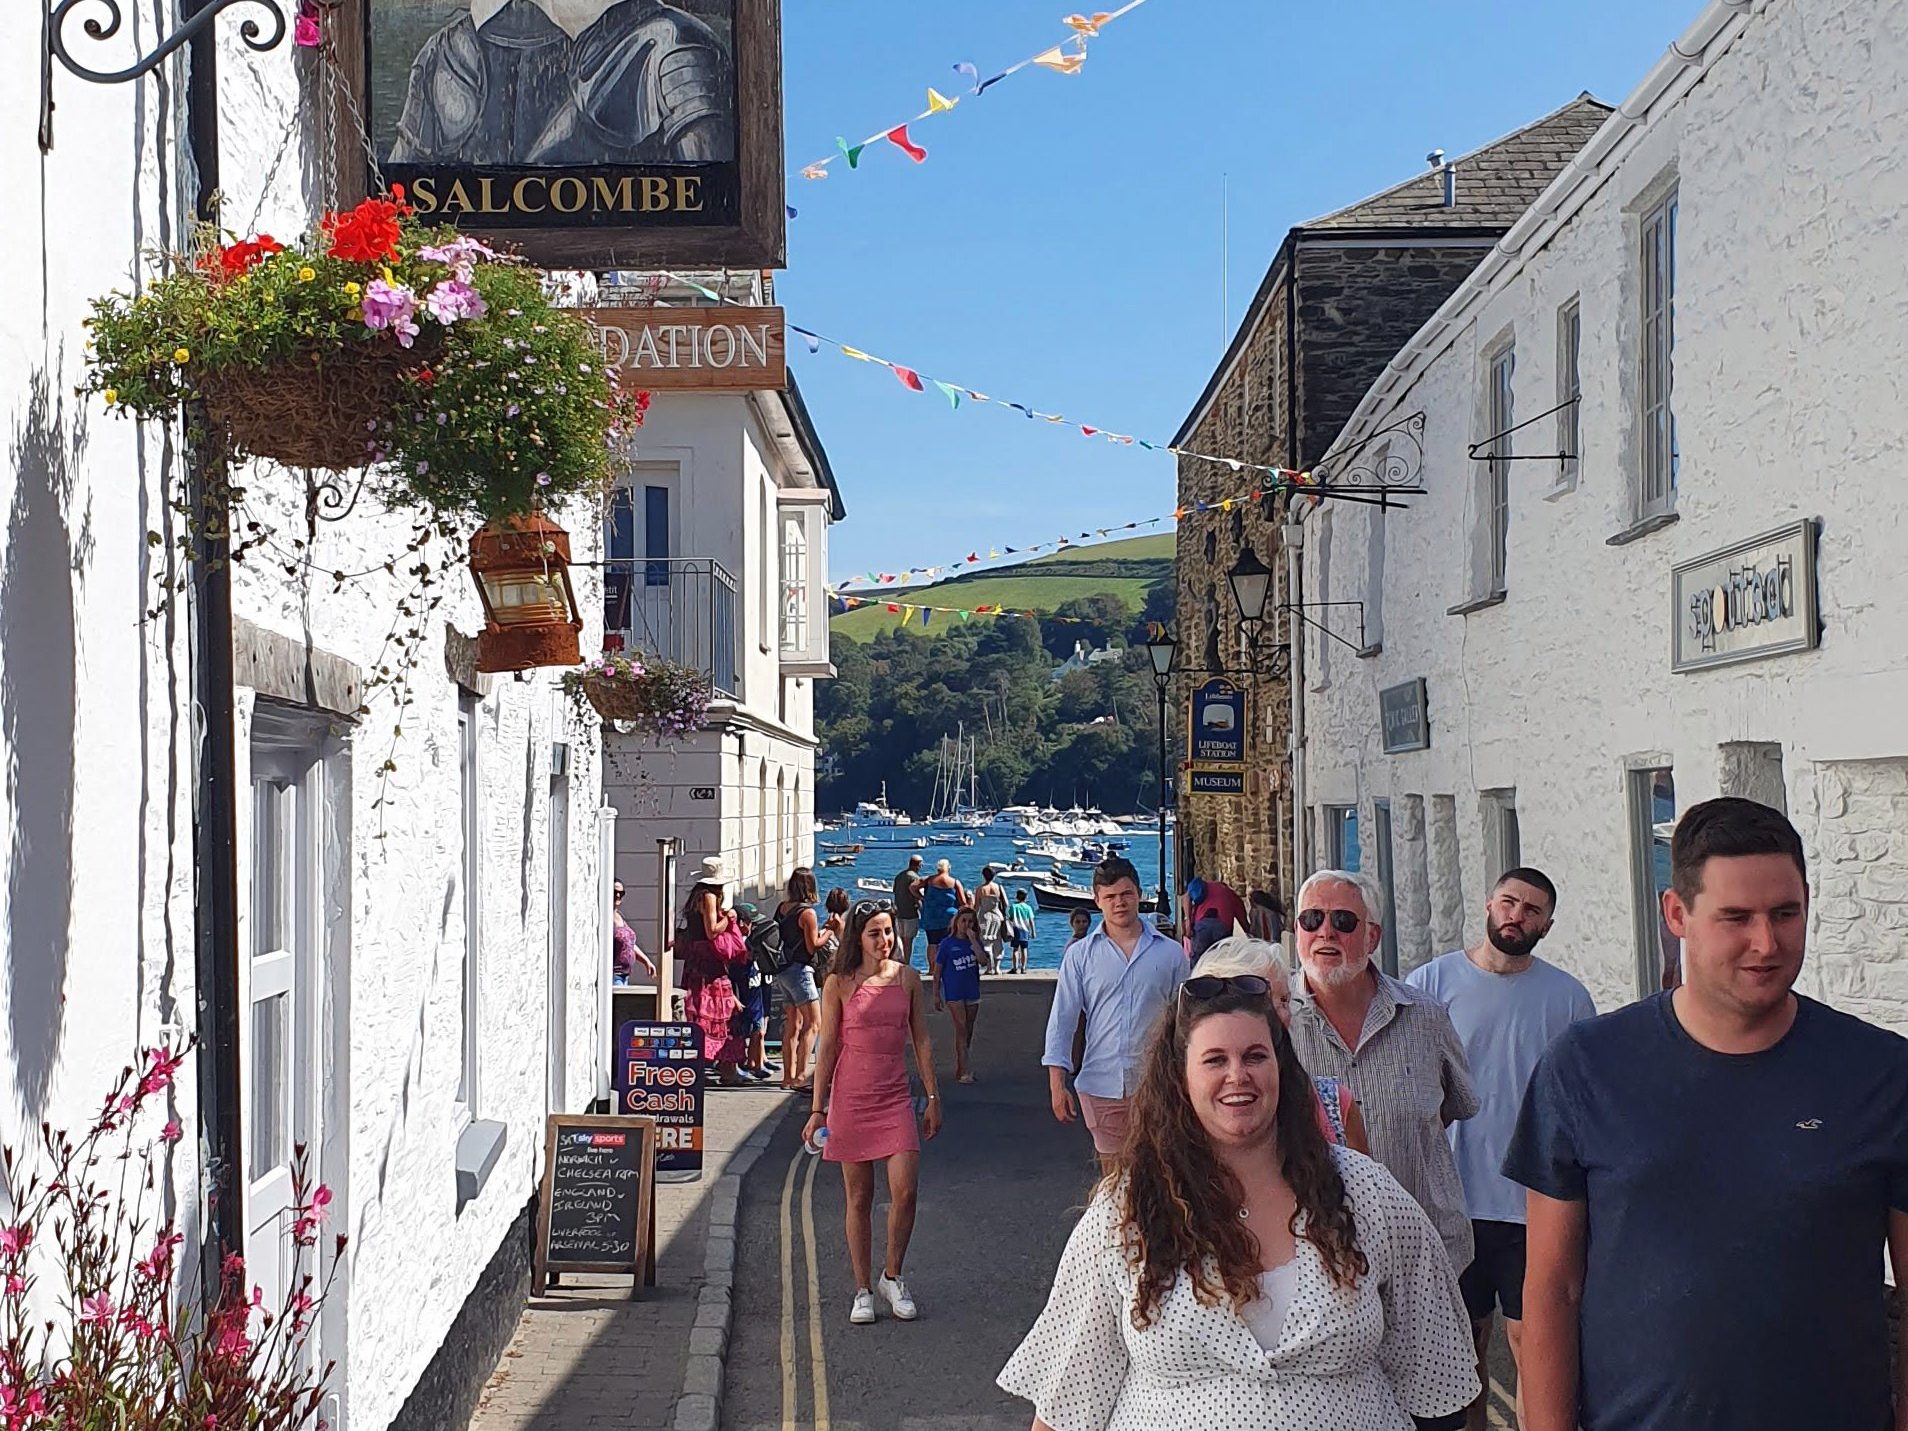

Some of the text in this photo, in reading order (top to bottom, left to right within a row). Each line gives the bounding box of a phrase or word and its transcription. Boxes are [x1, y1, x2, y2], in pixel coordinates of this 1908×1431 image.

[411, 176, 704, 214] SALCOMBE
[1198, 740, 1237, 750] LIFEBOAT
[1200, 749, 1236, 758] STATION
[1194, 777, 1241, 788] MUSEUM
[628, 1061, 696, 1086] Free
[627, 1088, 695, 1111] Cash
[594, 1135, 624, 1144] sports
[557, 1168, 612, 1179] CHELSEA
[554, 1187, 616, 1198] ENGLAND
[553, 1200, 612, 1212] IRELAND
[550, 1240, 599, 1250] ARSENAL
